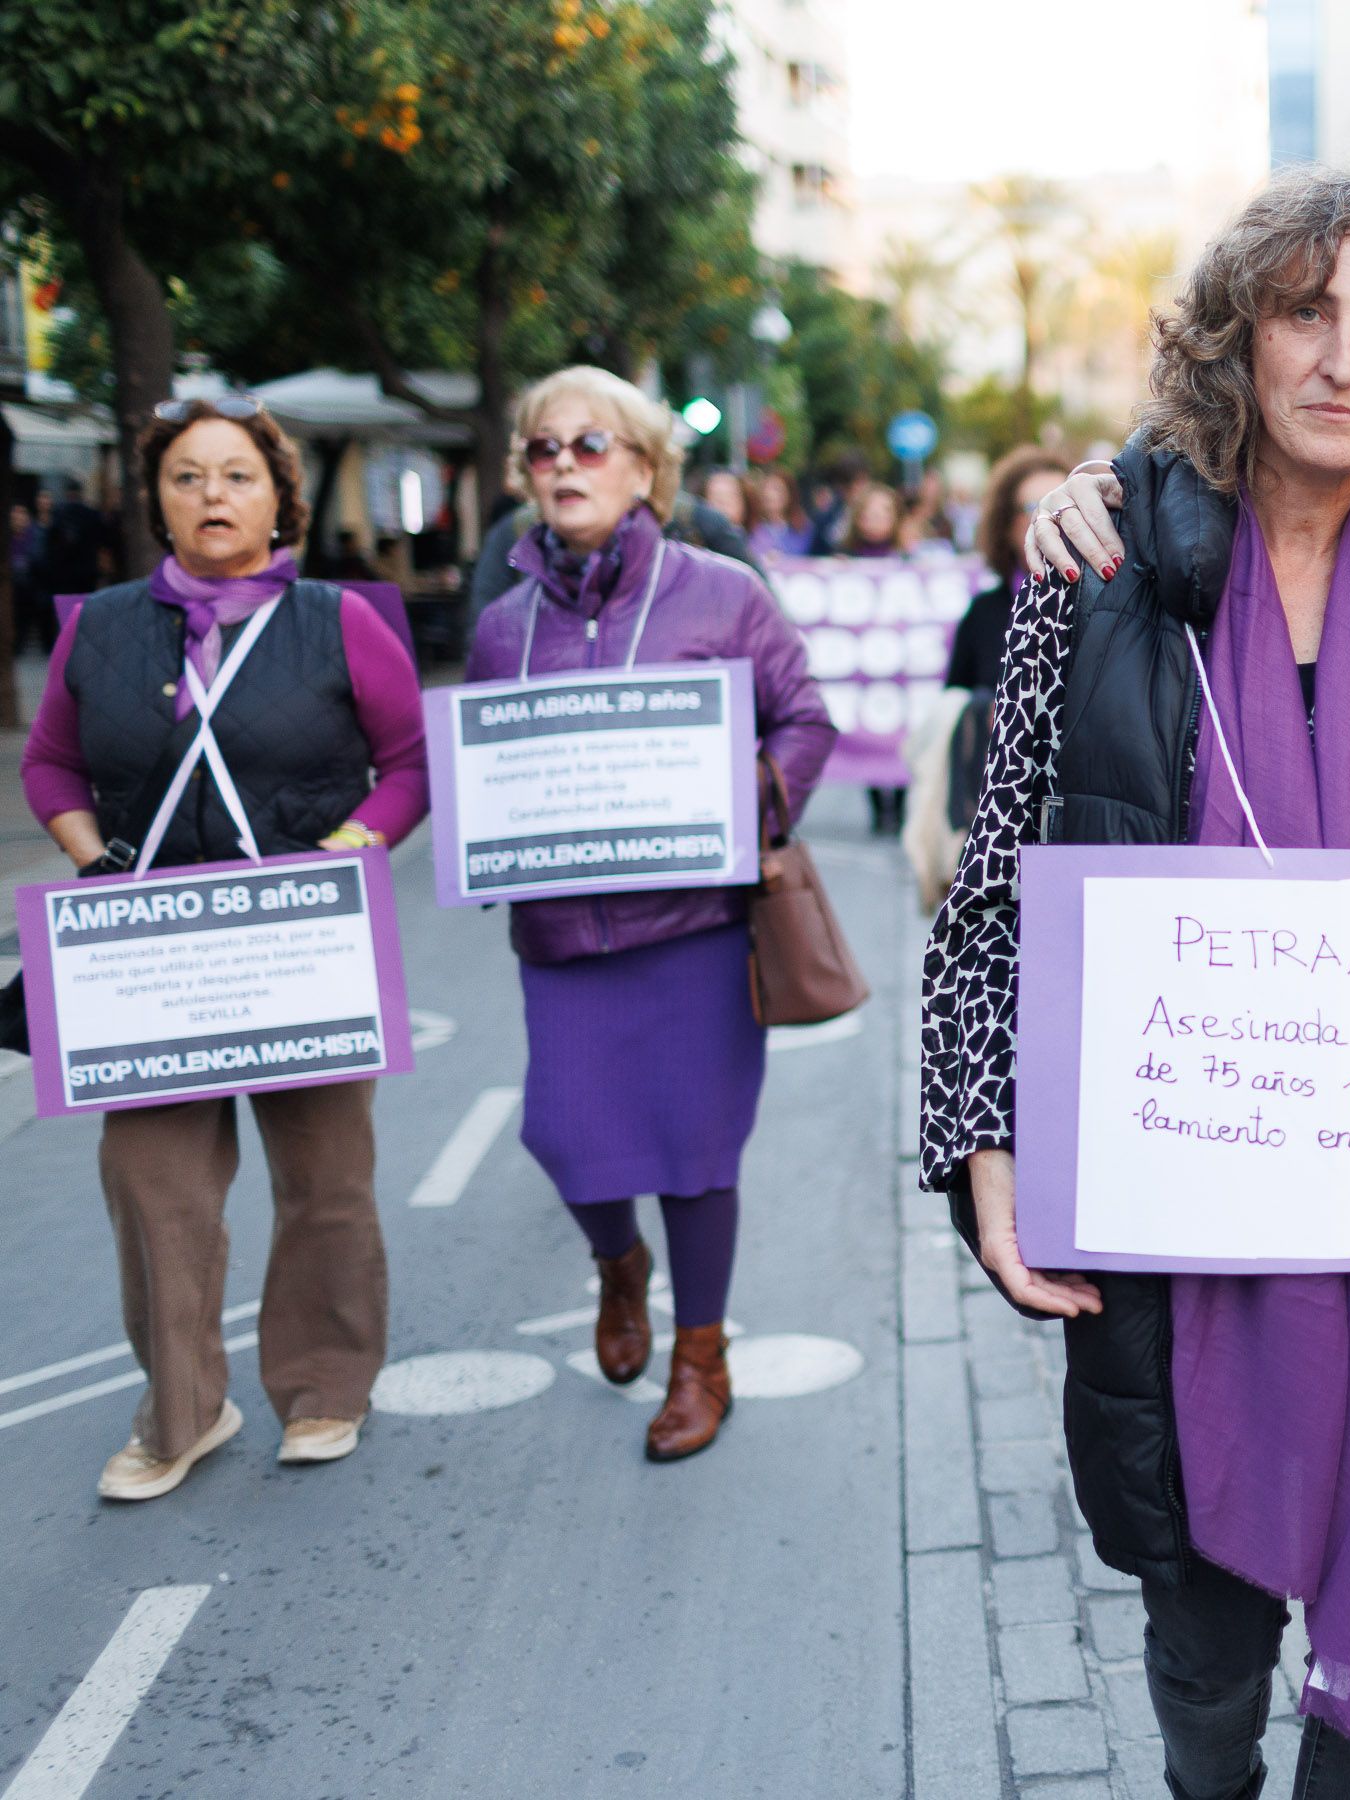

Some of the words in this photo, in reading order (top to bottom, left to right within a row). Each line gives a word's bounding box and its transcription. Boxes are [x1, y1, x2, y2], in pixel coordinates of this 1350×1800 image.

[480, 701, 529, 726] SARA
[534, 692, 615, 719] ABIGAIL
[648, 689, 702, 712] años
[469, 852, 515, 877] STOP
[517, 841, 614, 870] VIOLENCIA
[614, 834, 724, 861] MACHISTA
[56, 890, 203, 933] ÁMPARO
[212, 885, 252, 915] 58
[260, 880, 340, 911] años
[89, 947, 164, 963] Asesinada
[169, 944, 187, 954] en
[191, 938, 242, 953] agosto
[128, 966, 156, 978] que
[209, 958, 227, 967] un
[232, 953, 269, 964] arma
[186, 980, 194, 989] y
[188, 1005, 251, 1023] SEVILLA
[1142, 996, 1347, 1045] Asesinada
[69, 1060, 133, 1088] STOP
[135, 1046, 259, 1079] VIOLENCIA
[262, 1029, 380, 1064] MACHISTA
[1136, 1052, 1177, 1083] de
[1203, 1055, 1239, 1087] 75
[1252, 1072, 1314, 1096] años
